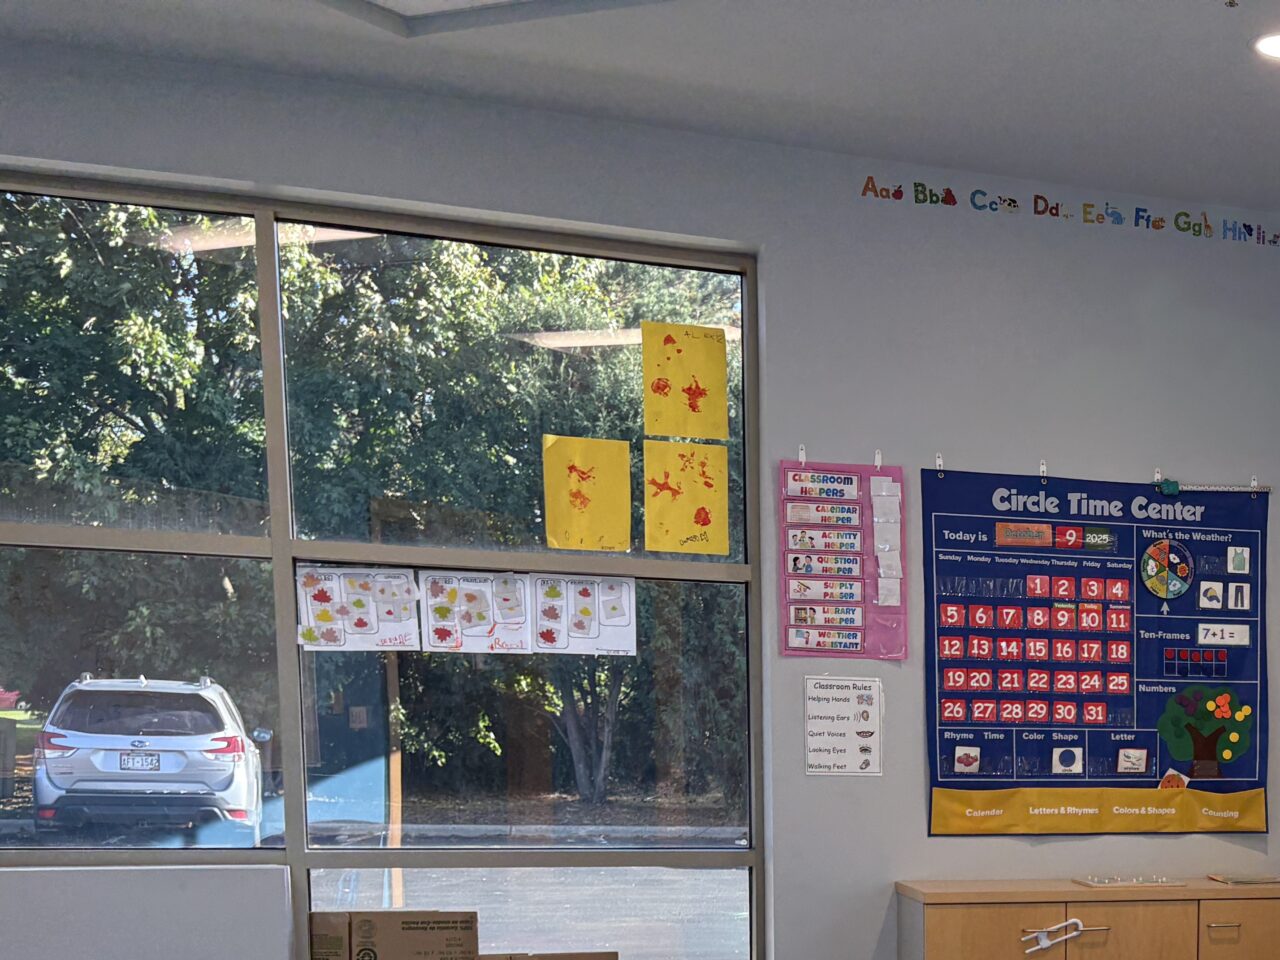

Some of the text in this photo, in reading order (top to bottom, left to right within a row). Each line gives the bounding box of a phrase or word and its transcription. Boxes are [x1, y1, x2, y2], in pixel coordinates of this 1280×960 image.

[992, 488, 1205, 521] Circle Time Center
[943, 530, 976, 543] Today
[979, 532, 988, 541] is
[1066, 530, 1076, 545] 9
[1086, 534, 1108, 543] 2025
[1142, 530, 1232, 542] What's the Weather?
[938, 554, 962, 562] Sunday
[967, 555, 992, 563] Monday
[995, 556, 1019, 564] Tuesday
[1020, 558, 1051, 566] Wednesday
[1051, 559, 1078, 567] Thursday
[1034, 578, 1123, 597] 1 2 3 4
[947, 607, 1126, 627] 5 6 7 8 9 10 11
[1139, 630, 1190, 640] Ten-Frames
[944, 640, 1127, 659] 12 13 14 15 16 17 18
[814, 682, 850, 690] Classroom
[948, 672, 1127, 690] 19 20 21 22 23 24 25
[1139, 684, 1176, 693] Numbers
[944, 703, 1103, 720] 26 27 28 29 30 31
[808, 714, 835, 722] Listening
[808, 730, 825, 738] Quiet
[944, 732, 1004, 740] Rhyme Time
[1052, 733, 1078, 742] Shape
[1111, 733, 1136, 741] Letter
[966, 808, 1004, 817] Calendar
[1029, 807, 1058, 815] Letters
[1067, 807, 1099, 815] Rhymes
[1113, 806, 1139, 814] Colors
[1147, 807, 1176, 815] Shapes
[1202, 808, 1239, 819] Counting
